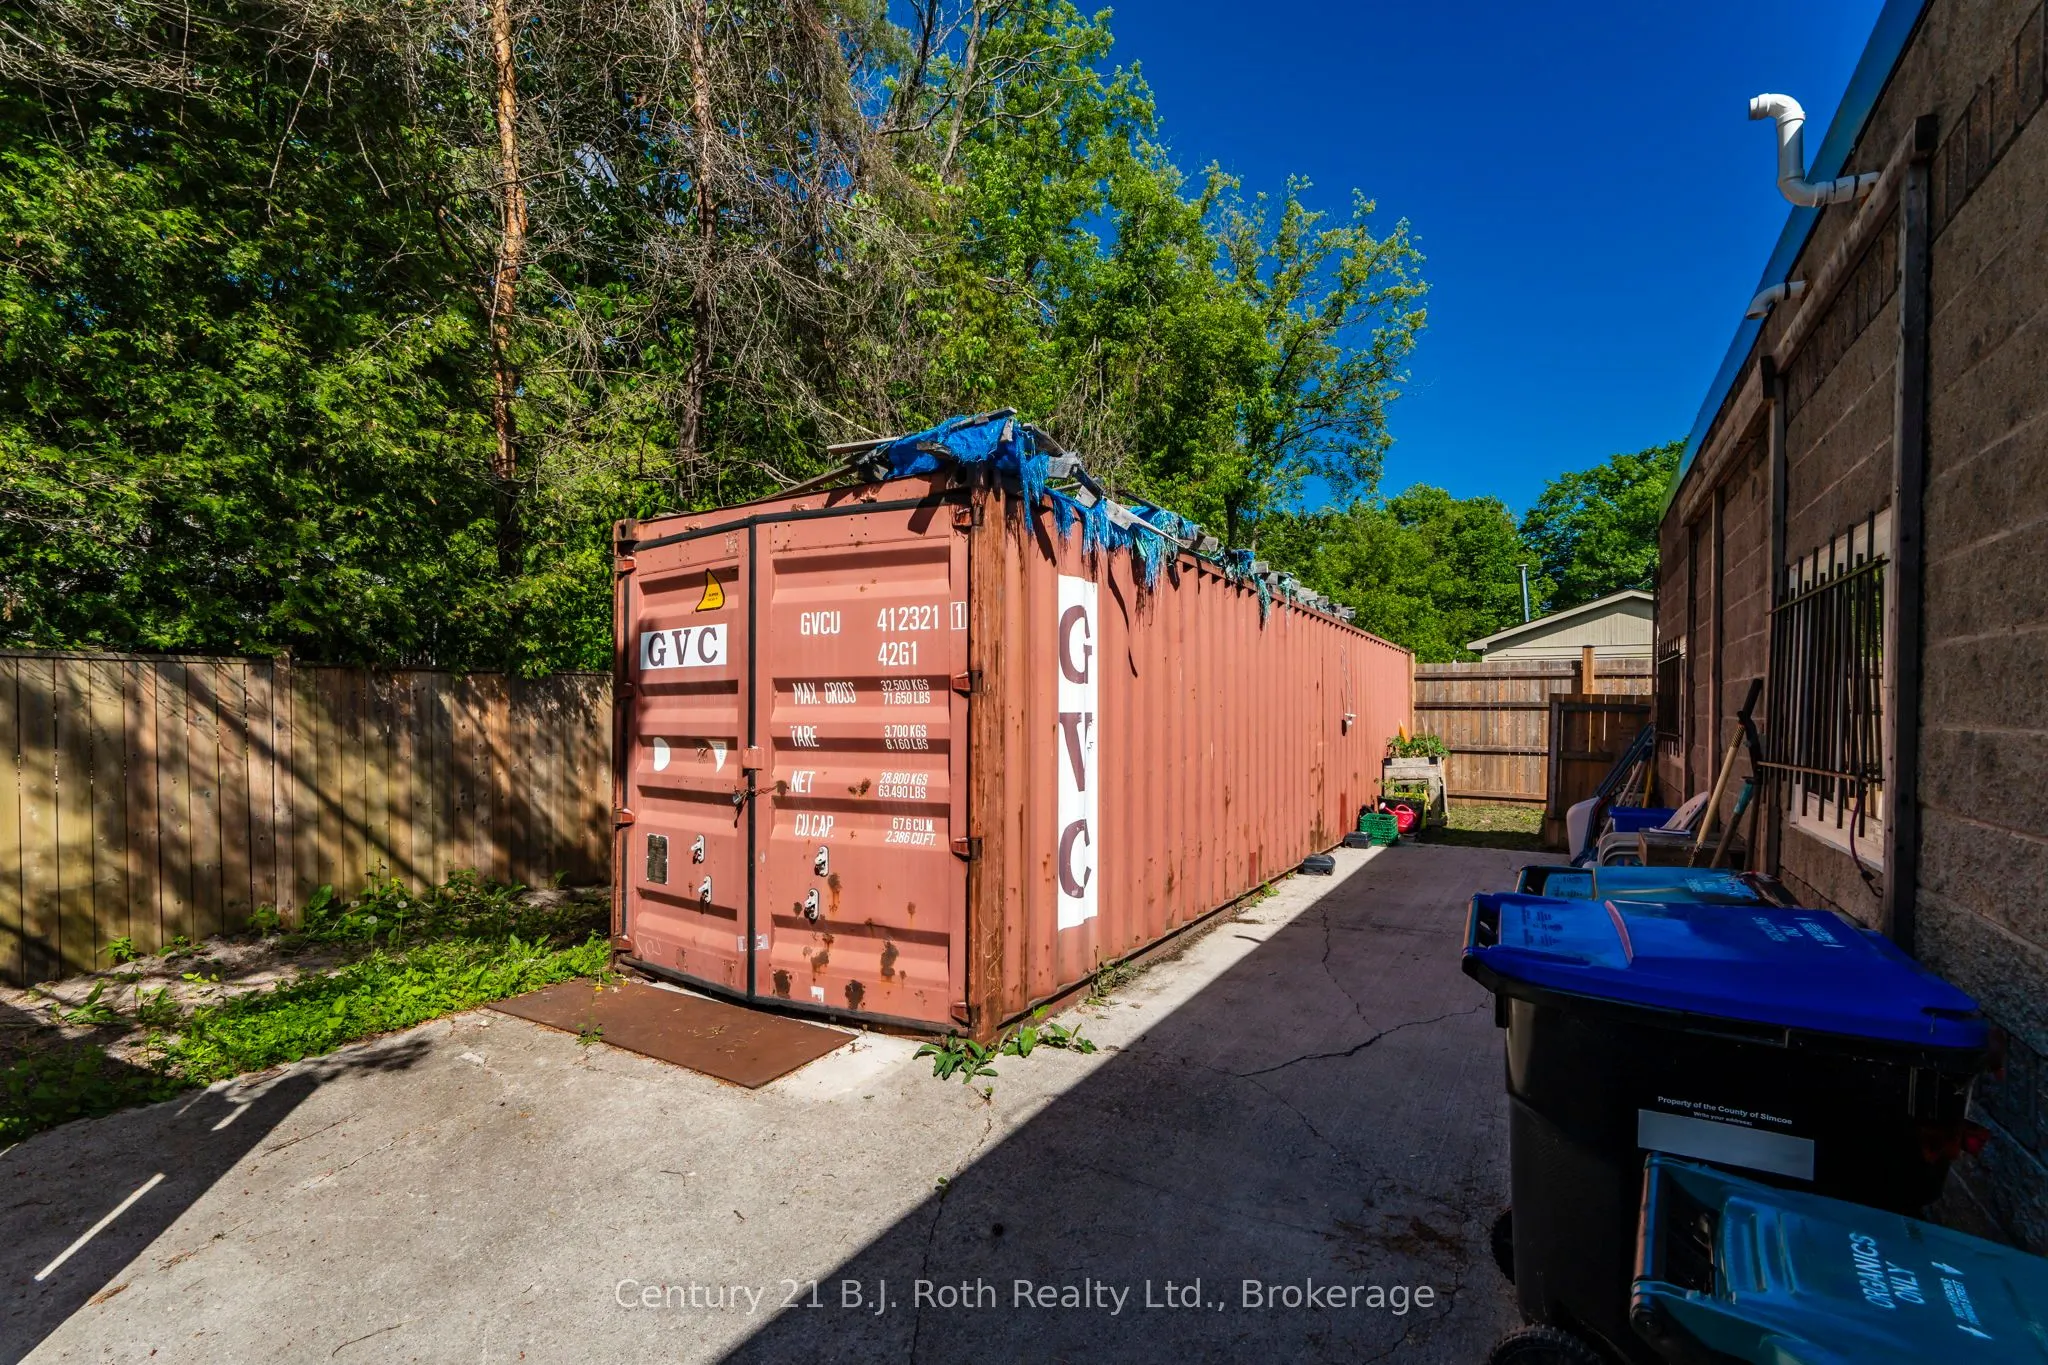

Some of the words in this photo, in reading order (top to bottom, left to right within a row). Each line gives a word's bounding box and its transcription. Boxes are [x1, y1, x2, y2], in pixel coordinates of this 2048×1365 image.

[800, 610, 841, 635] GVCU
[876, 604, 939, 632] 412321
[648, 626, 718, 667] GVC
[877, 640, 917, 666] 42G1
[792, 682, 820, 705] MAX.
[824, 681, 857, 704] GROSS
[880, 679, 911, 691] 32.500
[911, 679, 929, 691] KGS
[883, 692, 912, 705] 71.650
[914, 691, 931, 704] LBS
[790, 725, 820, 747] TARE
[884, 725, 908, 738] 3.700
[910, 724, 927, 737] KGS
[886, 738, 911, 750] 8.160
[910, 738, 929, 750] LBS
[790, 770, 816, 793] NET
[880, 772, 910, 785] 28.800
[910, 773, 929, 786] KGS
[878, 785, 908, 798] 63.490
[909, 786, 926, 799] LBS
[892, 817, 912, 831] 67.6
[885, 830, 911, 844] 2.386
[1657, 1095, 1691, 1109] Property
[1703, 1103, 1716, 1111] the
[1718, 1105, 1748, 1118] County
[1760, 1113, 1793, 1125] Simcoe
[1849, 1230, 1896, 1309] ORGANICS
[1885, 1260, 1926, 1305] ONLY
